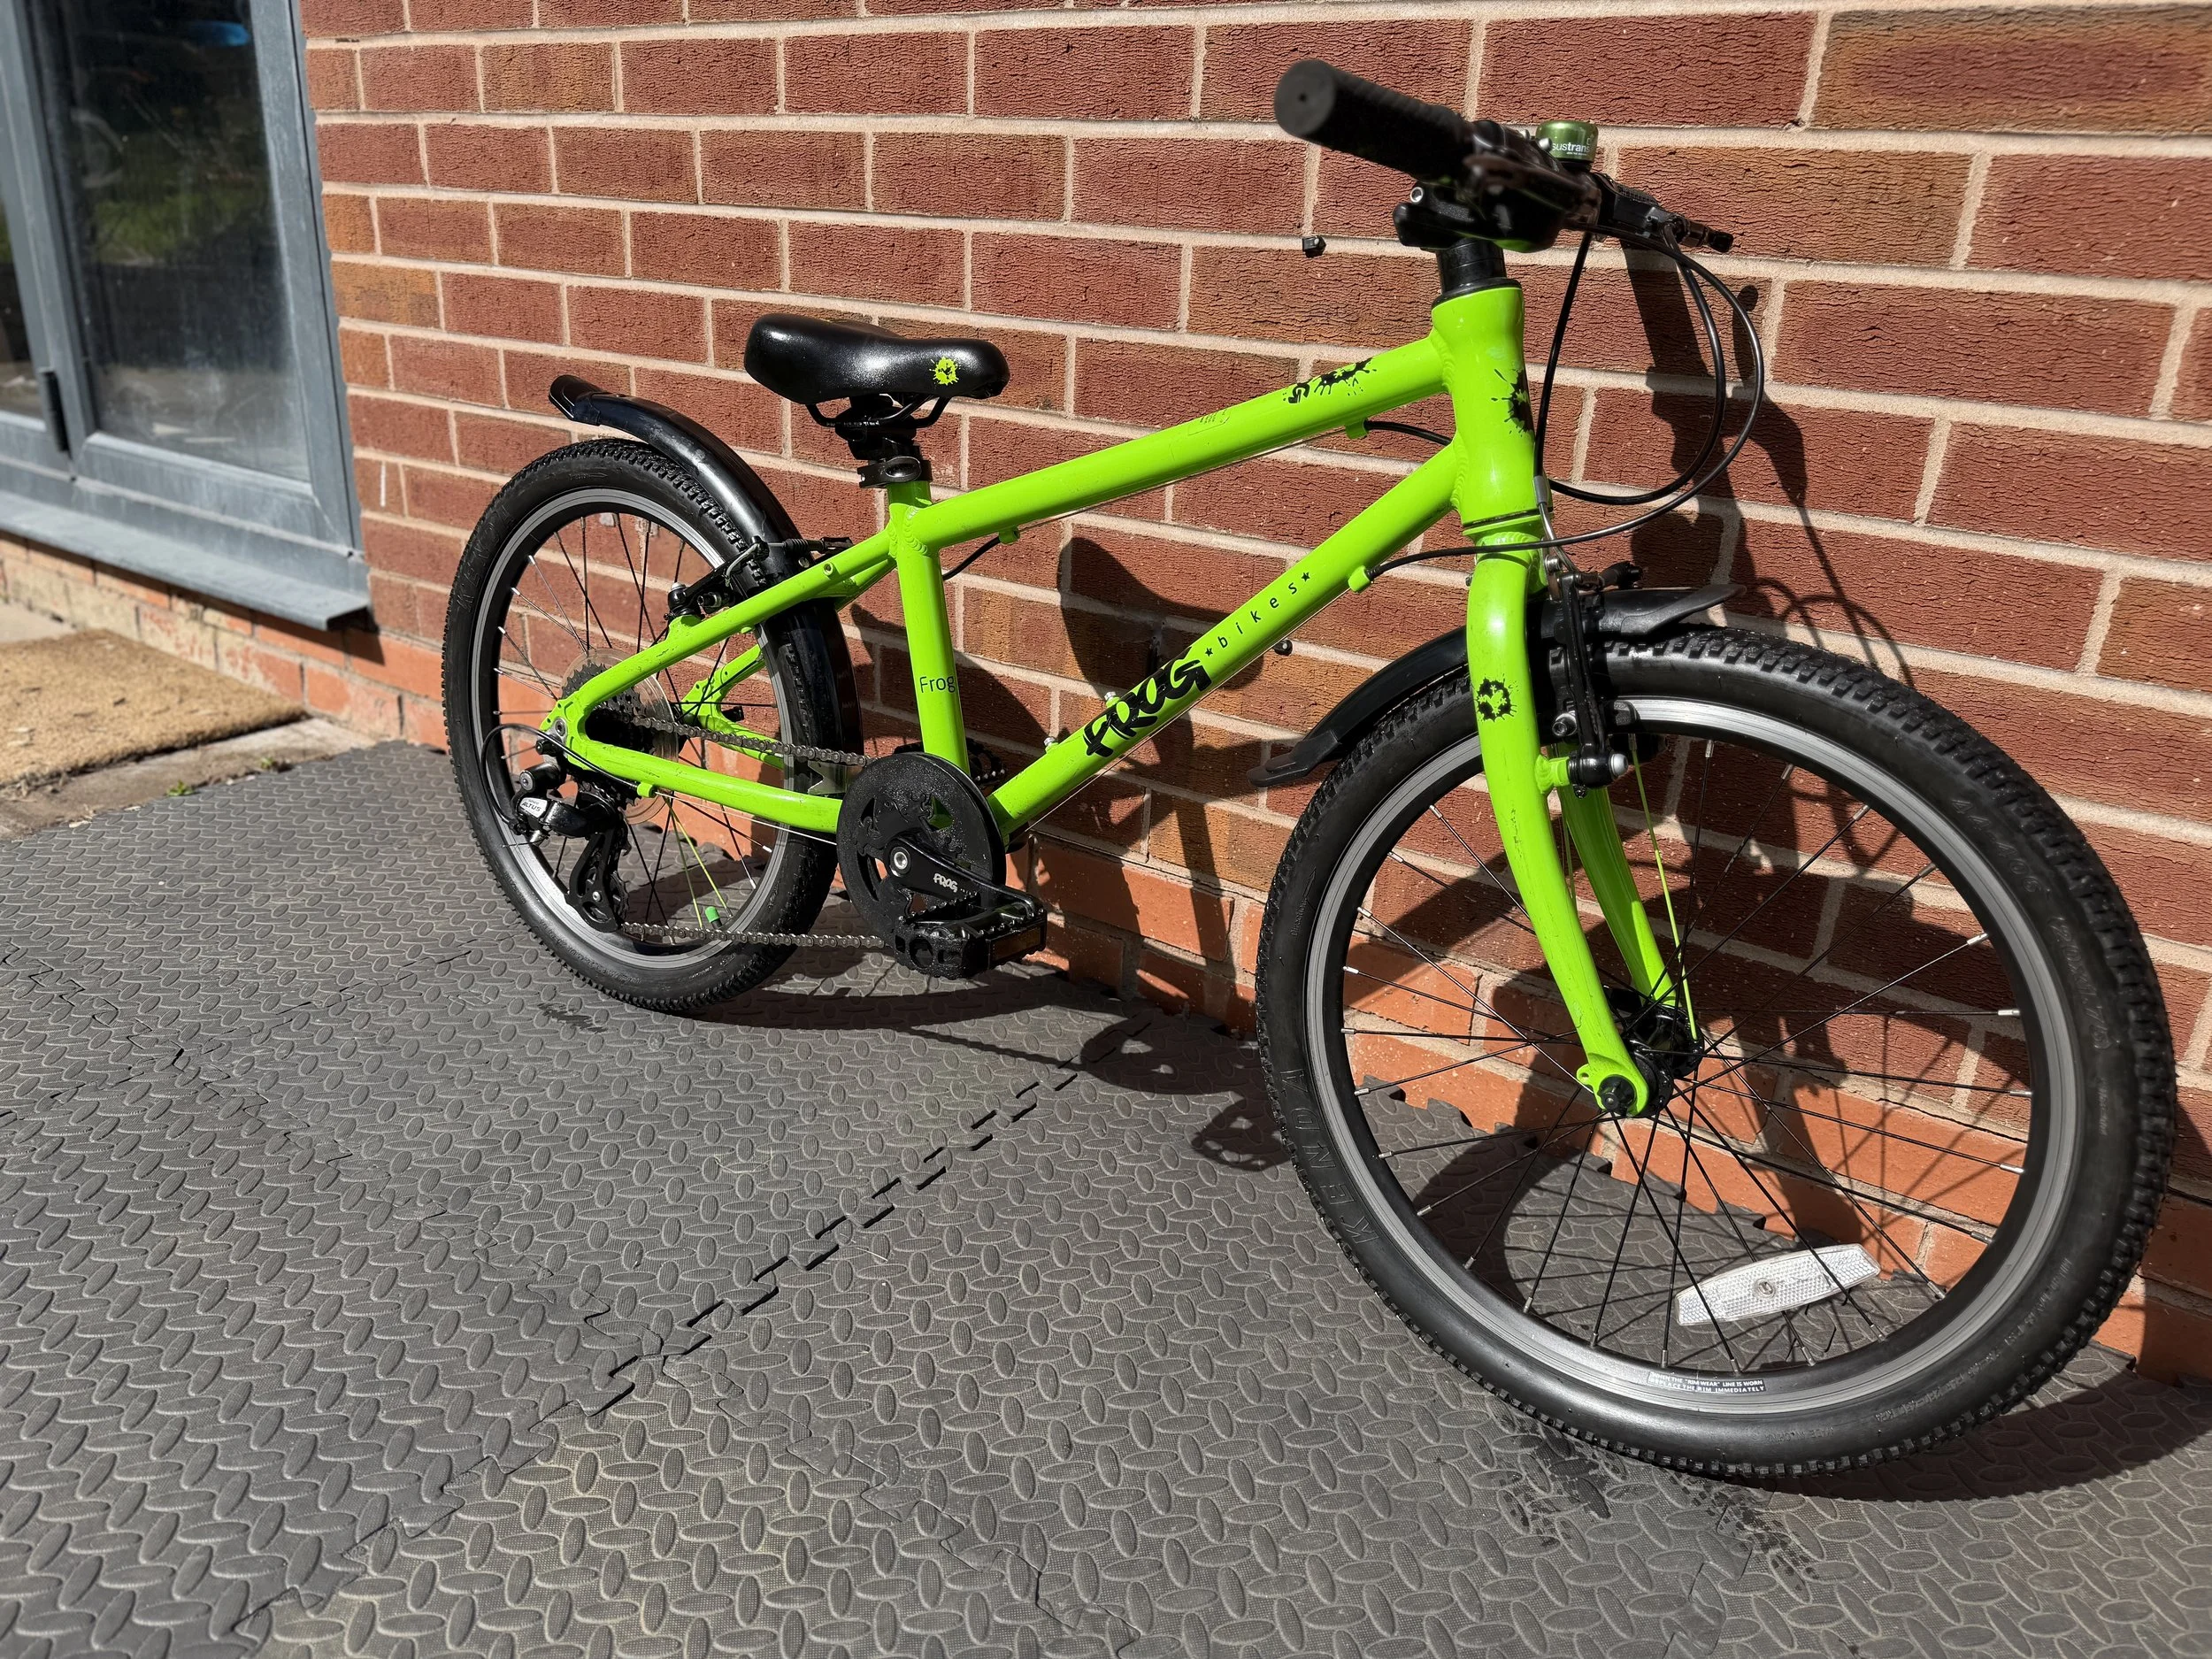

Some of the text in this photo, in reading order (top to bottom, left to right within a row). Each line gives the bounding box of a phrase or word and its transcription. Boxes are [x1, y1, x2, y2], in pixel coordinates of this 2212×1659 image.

[1552, 142, 1590, 153] sustrans
[1083, 582, 1297, 757] FROG bikes
[919, 676, 956, 693] Frog
[933, 872, 958, 893] FROG
[1280, 1069, 1379, 1243] KENDA
